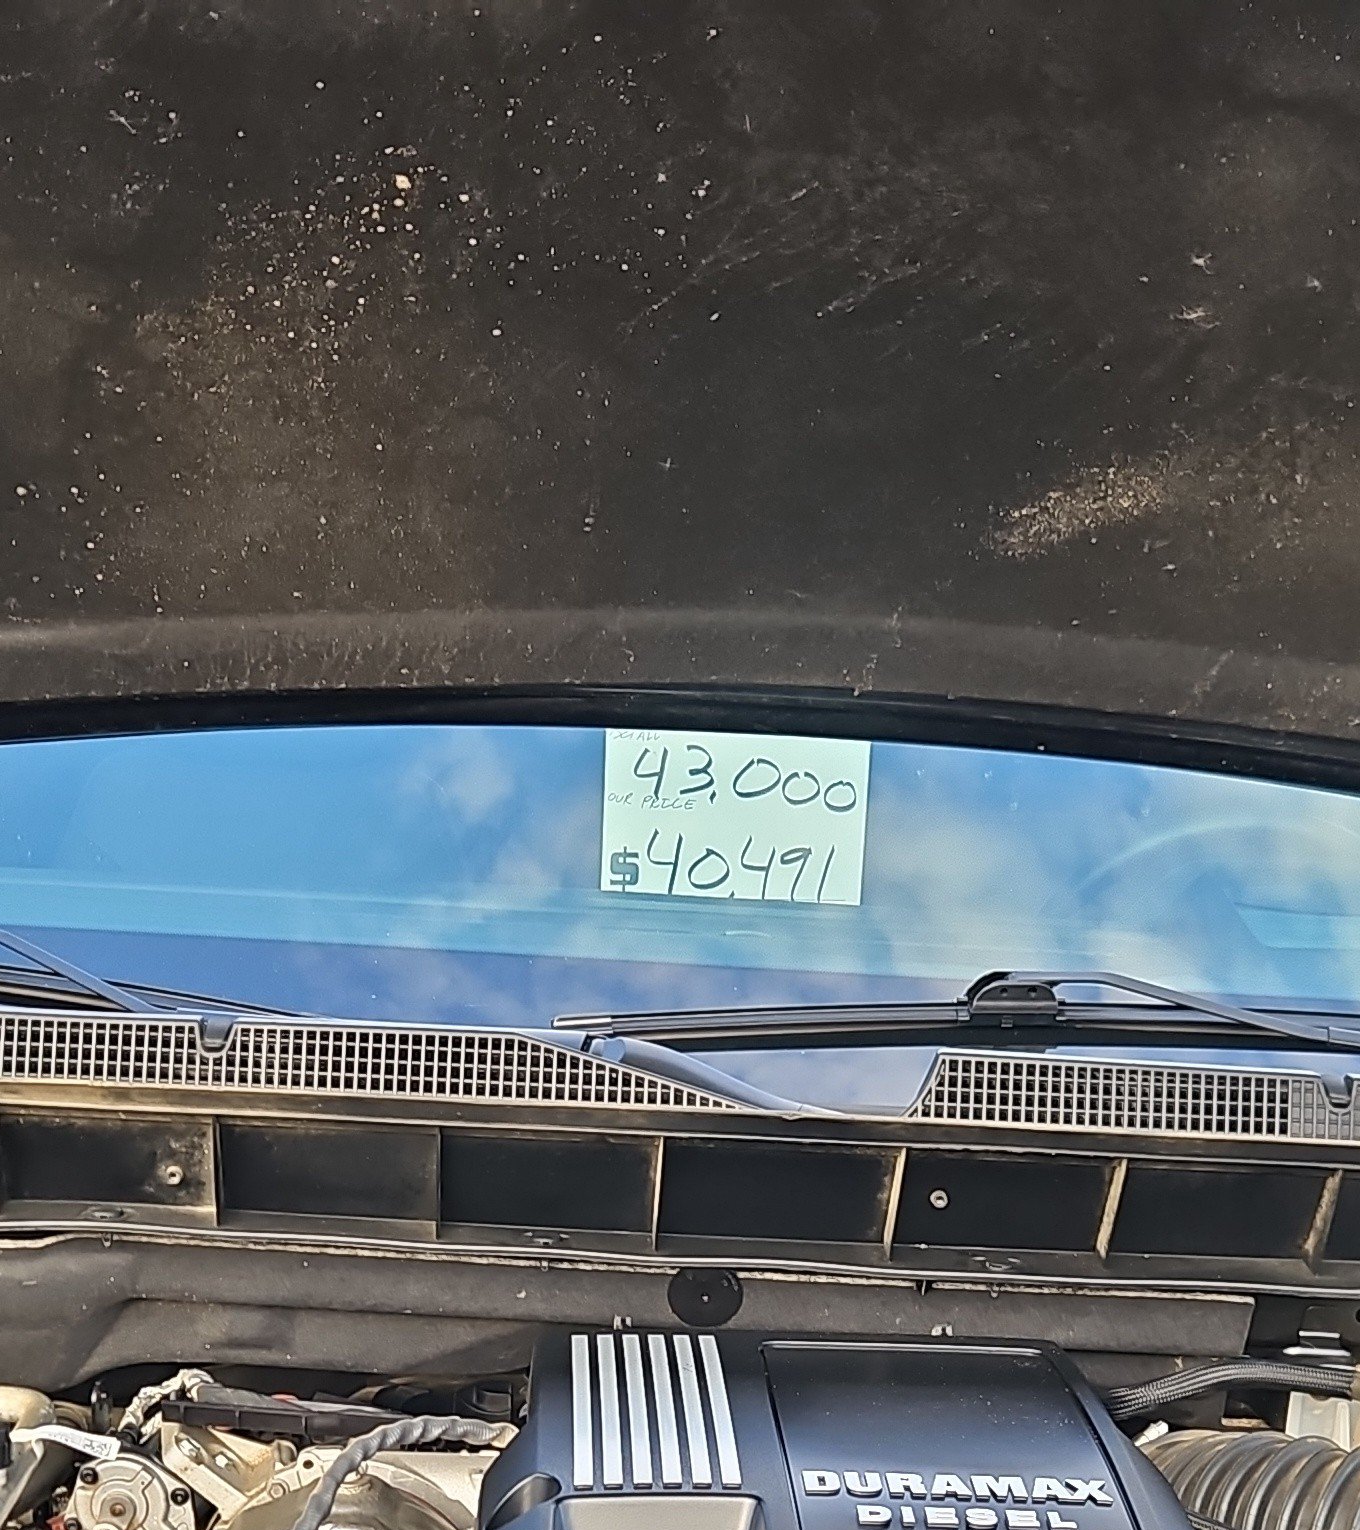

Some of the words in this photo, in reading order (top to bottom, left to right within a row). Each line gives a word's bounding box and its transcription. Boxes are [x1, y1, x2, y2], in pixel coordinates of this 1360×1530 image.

[634, 745, 857, 813] 43,000
[608, 792, 634, 805] OUR
[641, 795, 697, 810] PRICE
[801, 1470, 1114, 1506] DURAMAX
